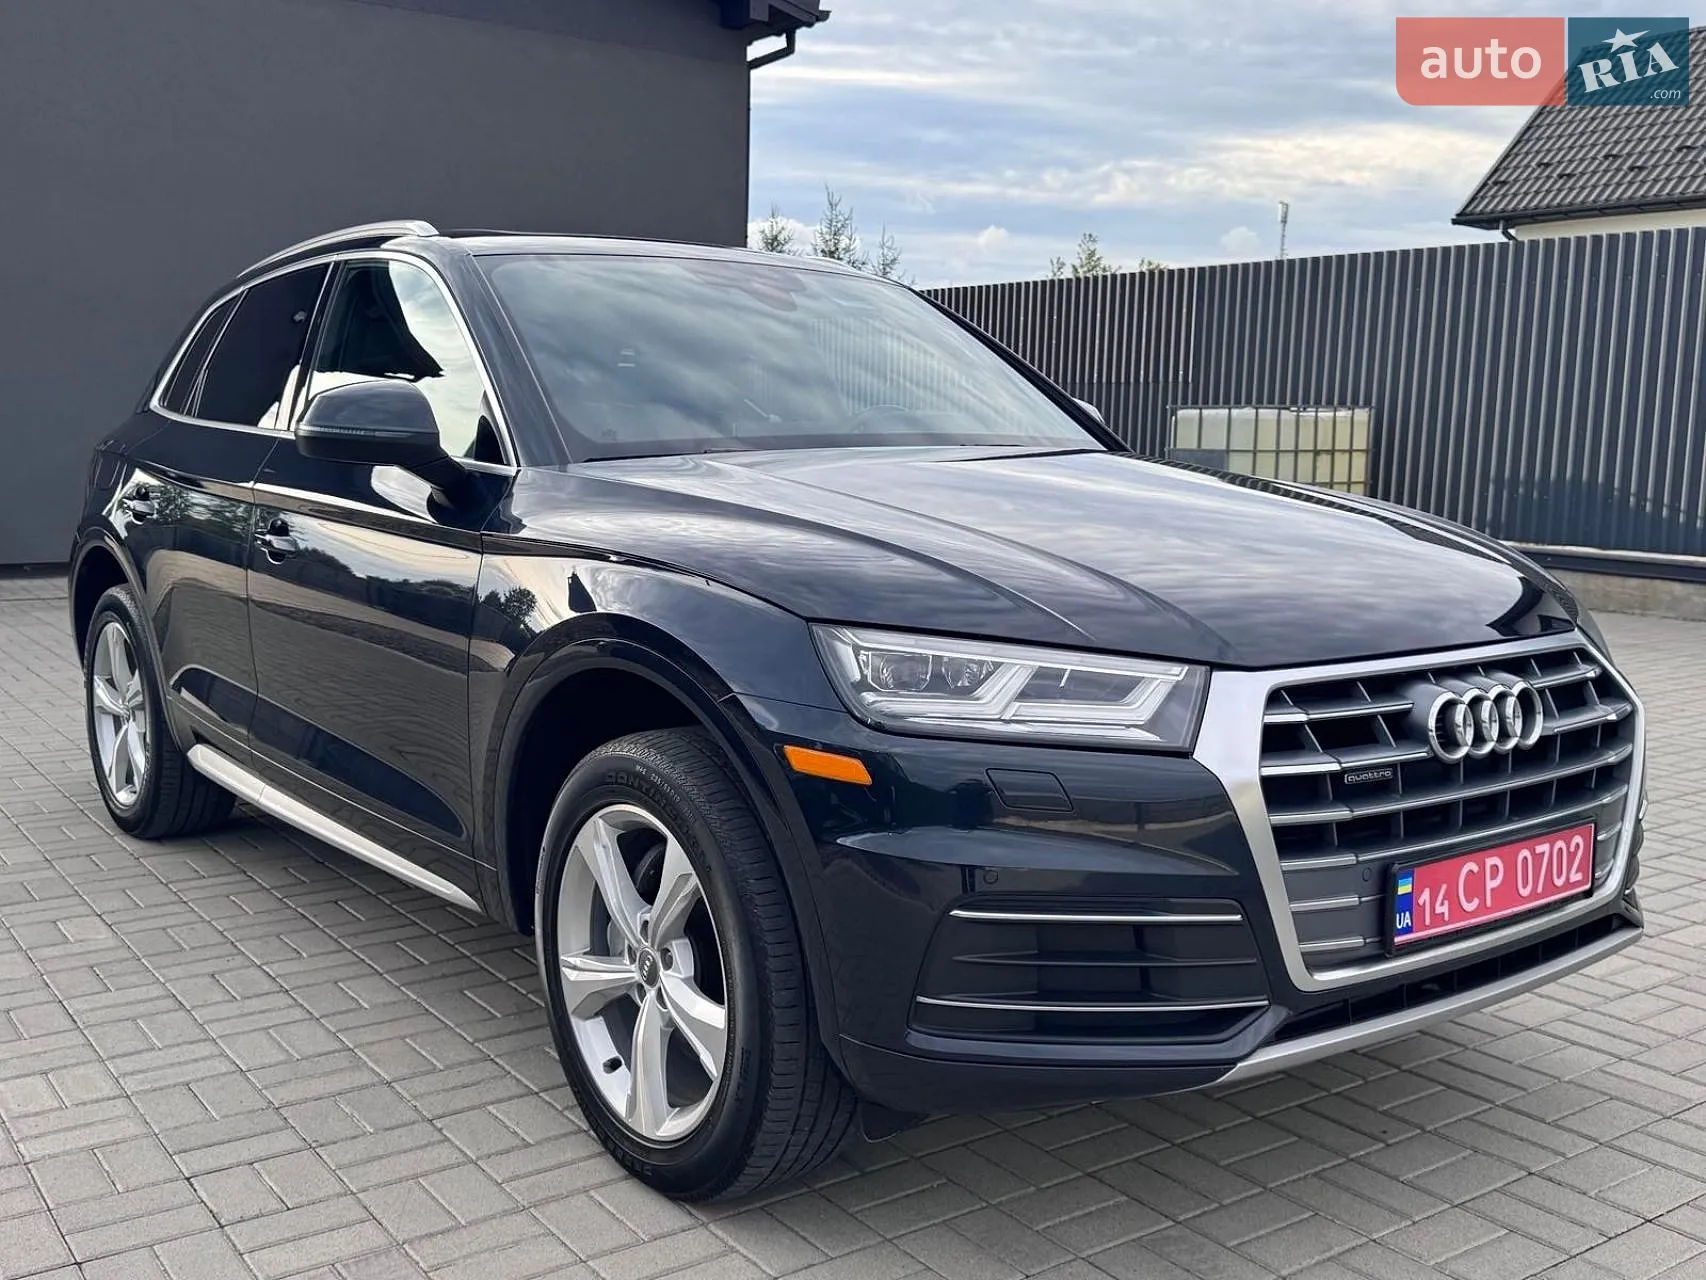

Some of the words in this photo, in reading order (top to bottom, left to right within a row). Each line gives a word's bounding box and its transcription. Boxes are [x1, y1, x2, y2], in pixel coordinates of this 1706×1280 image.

[1347, 770, 1392, 782] quattro
[1417, 883, 1450, 926] 14
[1458, 856, 1504, 913] CP
[1516, 834, 1584, 898] 0702
[1396, 911, 1412, 929] UA
